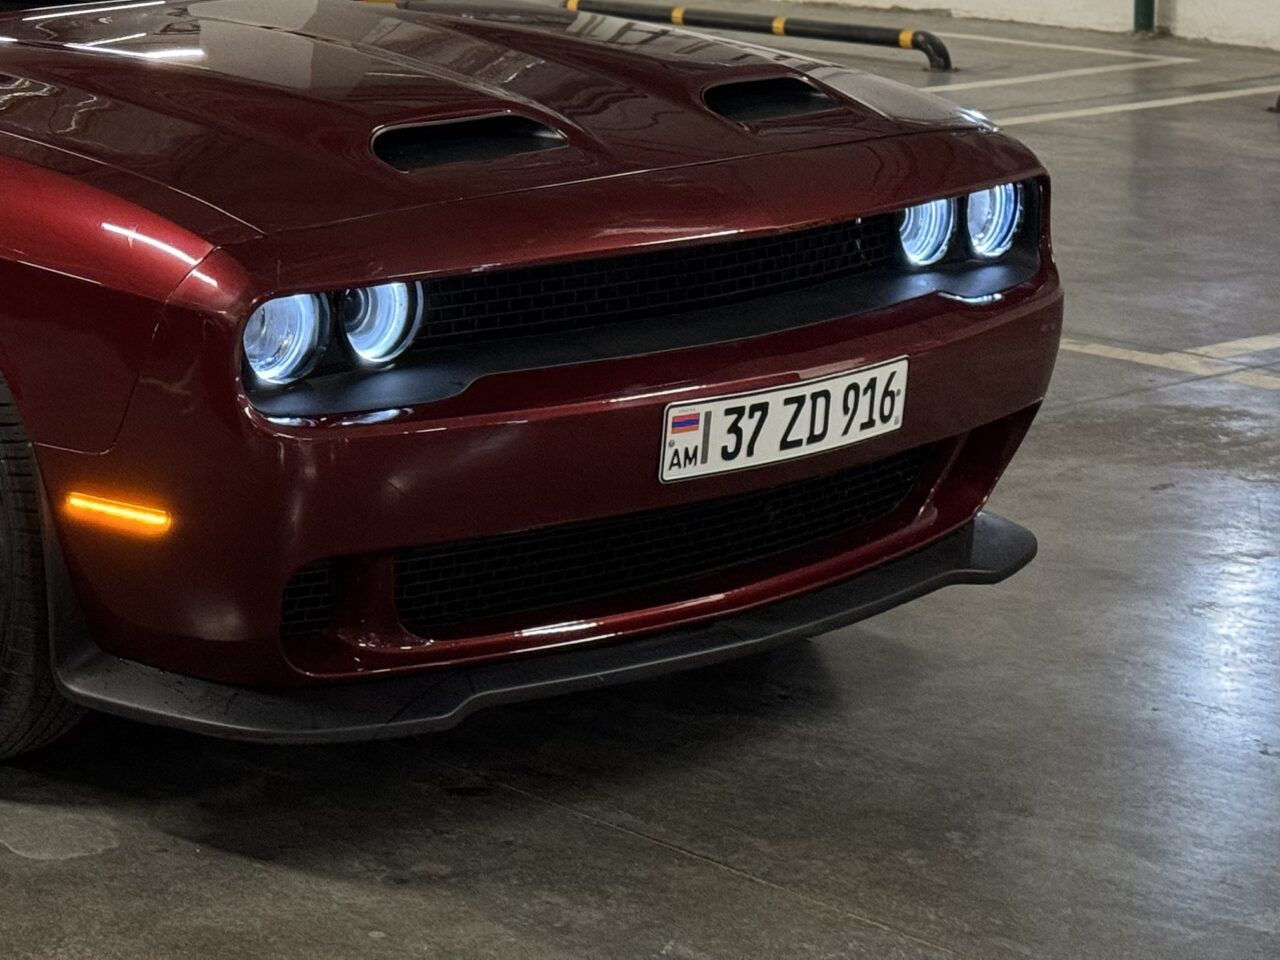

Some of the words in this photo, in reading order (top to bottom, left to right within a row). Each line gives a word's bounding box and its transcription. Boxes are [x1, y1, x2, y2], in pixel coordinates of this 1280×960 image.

[721, 401, 770, 461] 37
[779, 389, 831, 451] ZD
[841, 370, 897, 436] 916
[668, 444, 698, 471] AM
